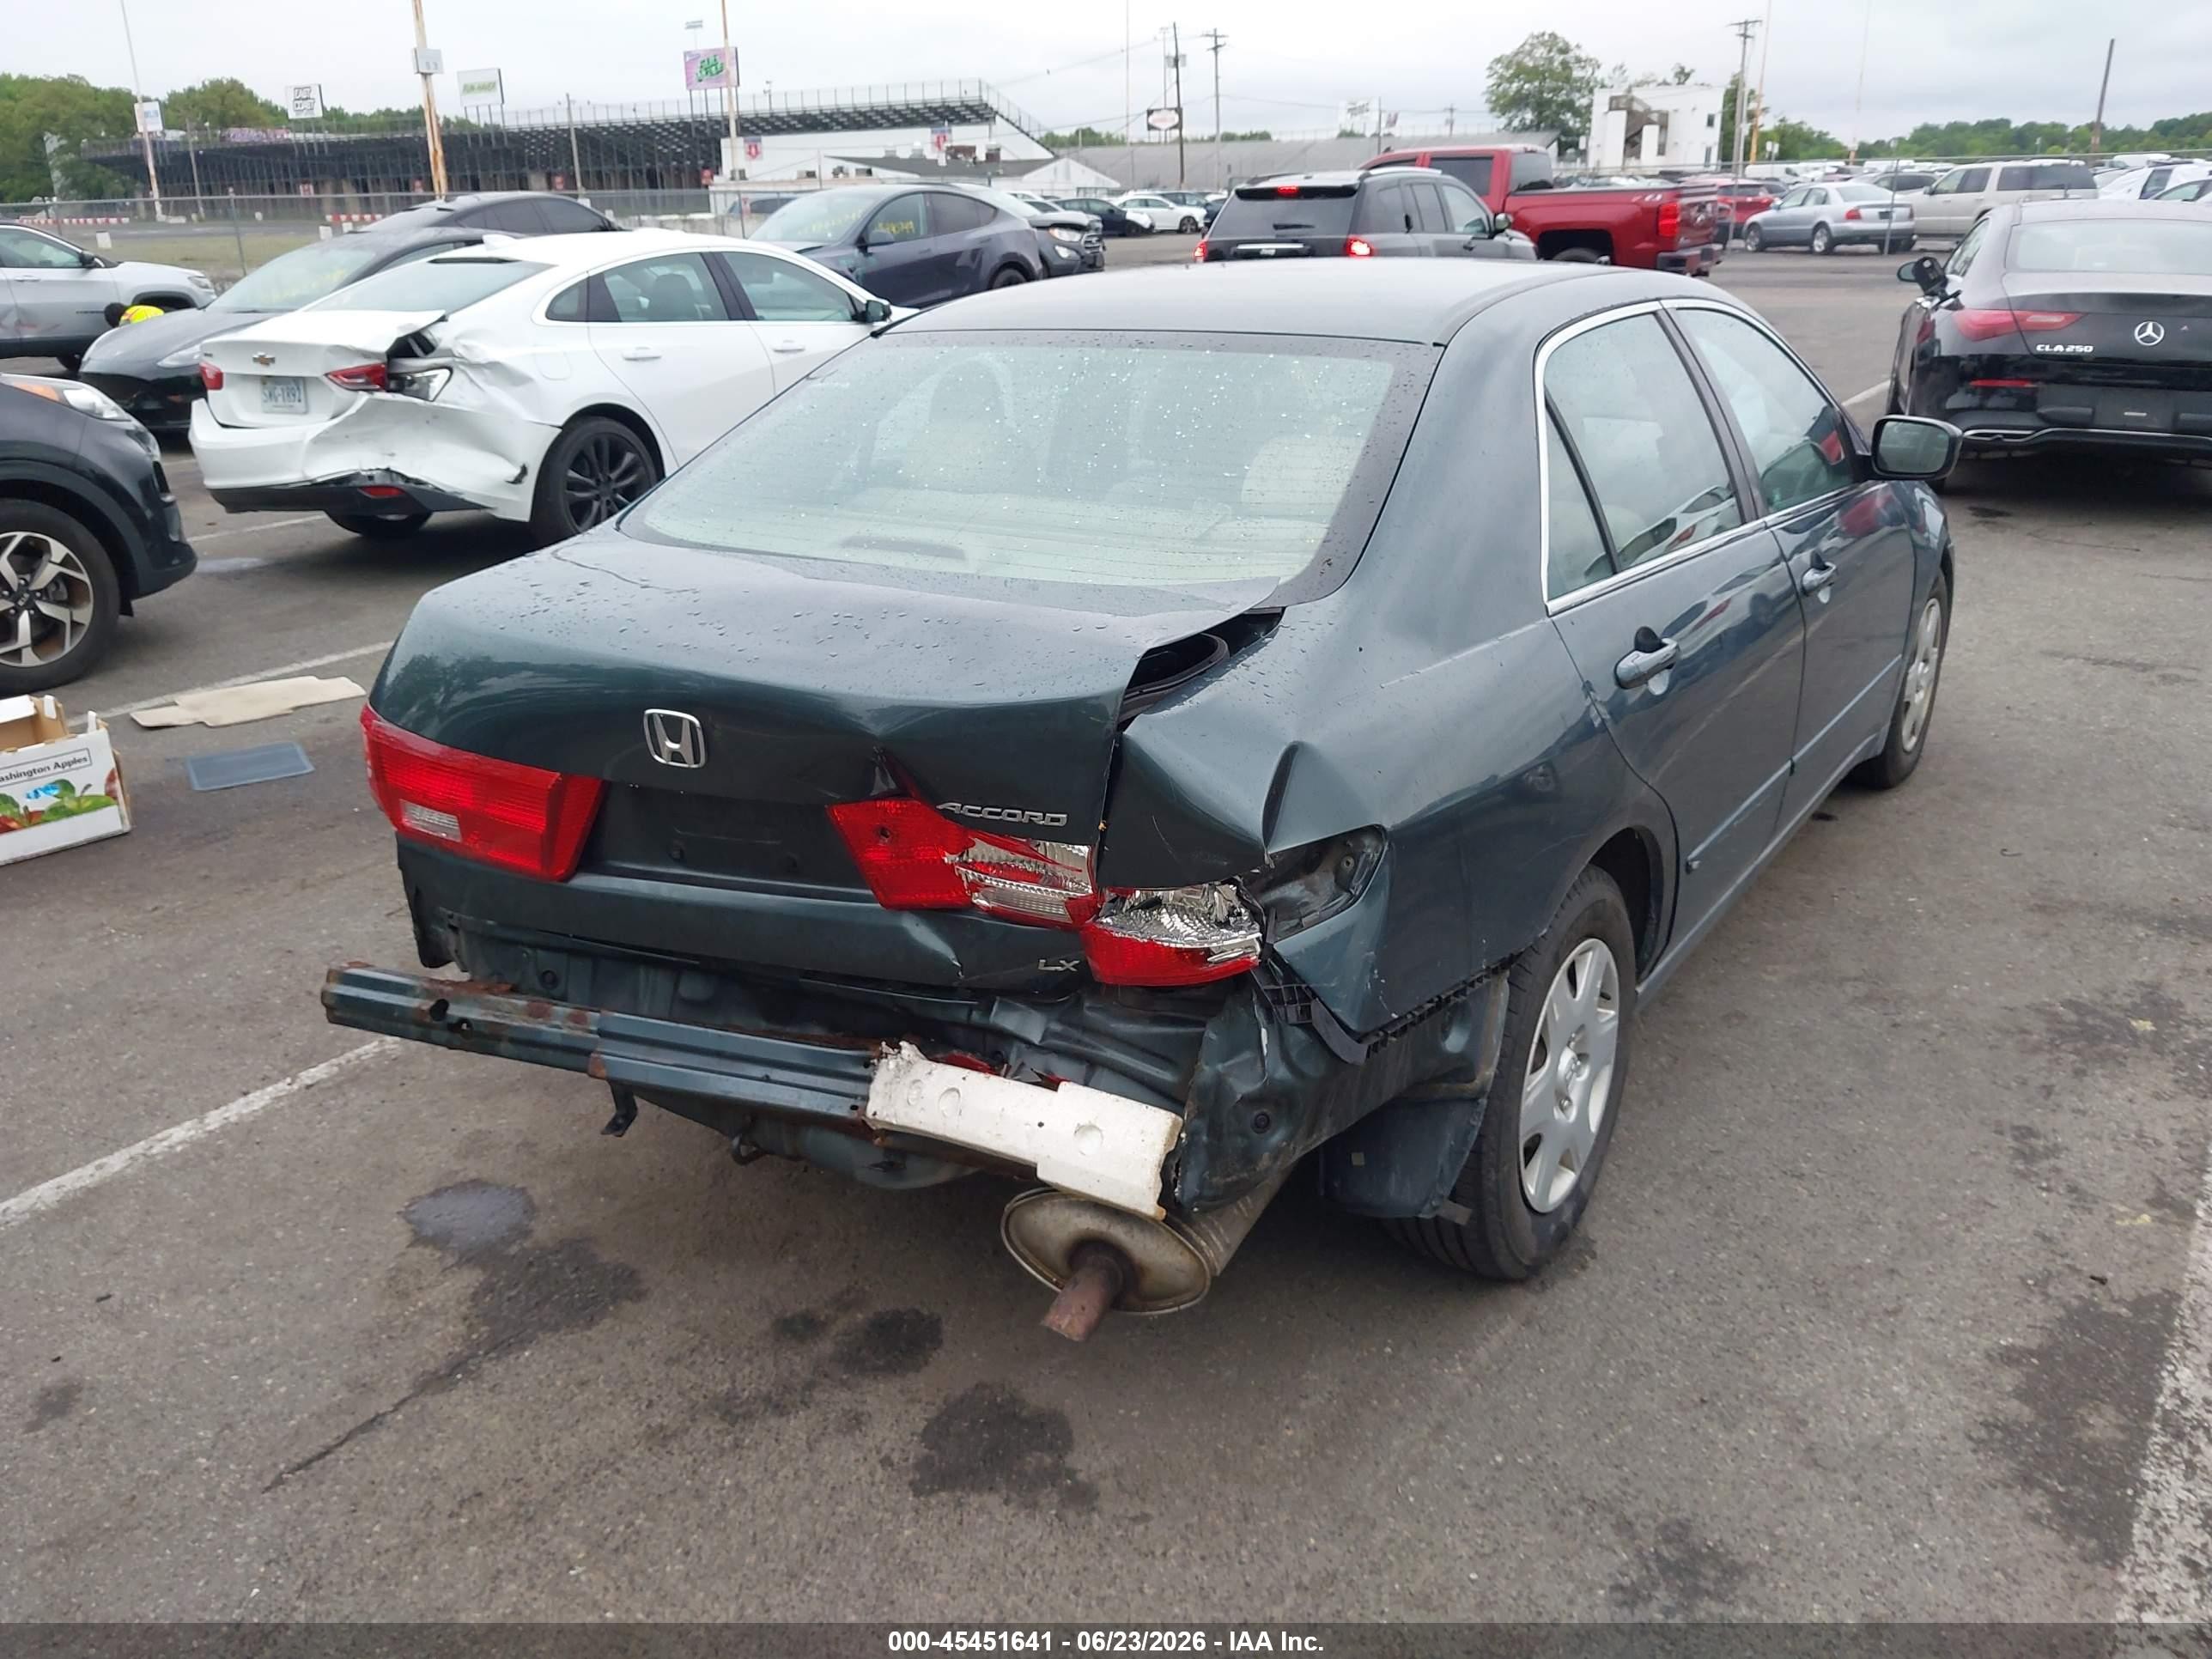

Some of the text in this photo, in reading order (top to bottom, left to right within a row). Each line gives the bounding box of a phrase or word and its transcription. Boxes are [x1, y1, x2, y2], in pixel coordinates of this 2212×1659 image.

[0, 757, 88, 783] ashington Apples
[936, 802, 1068, 827] ACCORD
[1038, 959, 1080, 971] LX
